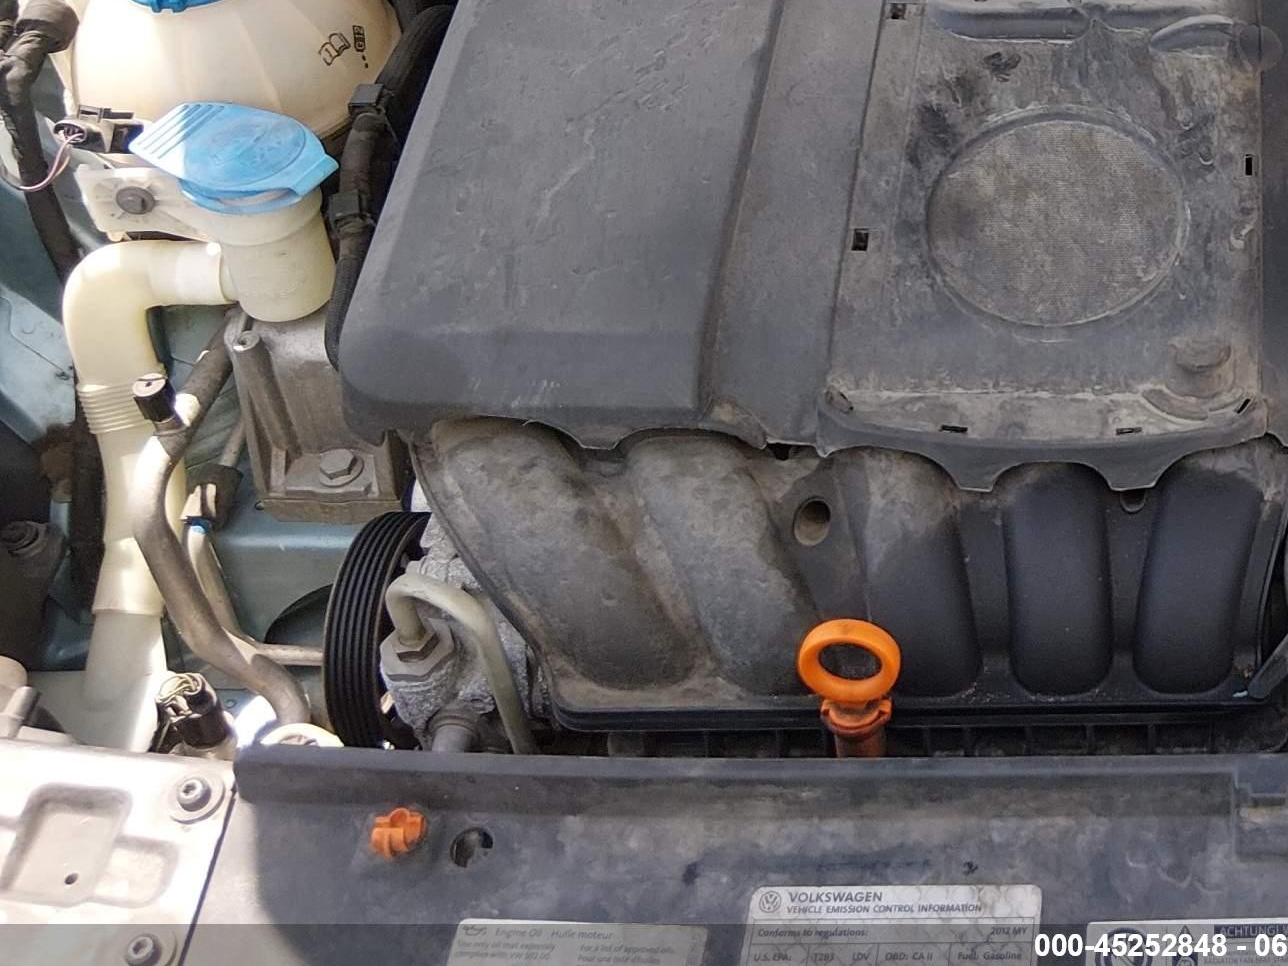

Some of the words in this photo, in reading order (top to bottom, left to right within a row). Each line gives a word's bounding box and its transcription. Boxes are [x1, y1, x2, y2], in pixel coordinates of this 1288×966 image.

[788, 891, 883, 903] VOLKSWAGEN
[787, 905, 823, 914] VEHICLE
[826, 905, 870, 914] EMISSION
[873, 904, 914, 913] CONTROL
[918, 903, 982, 913] INFORMATION
[495, 927, 527, 939] Engine
[530, 927, 543, 938] Oil
[550, 929, 577, 940] Huile
[578, 930, 614, 940] moteur
[758, 928, 801, 938] Conforms
[803, 929, 813, 937] to
[991, 926, 1011, 935] 2012
[1013, 926, 1028, 935] MY
[1220, 925, 1279, 936] ACHTUNG!
[983, 951, 1022, 961] Gasoline
